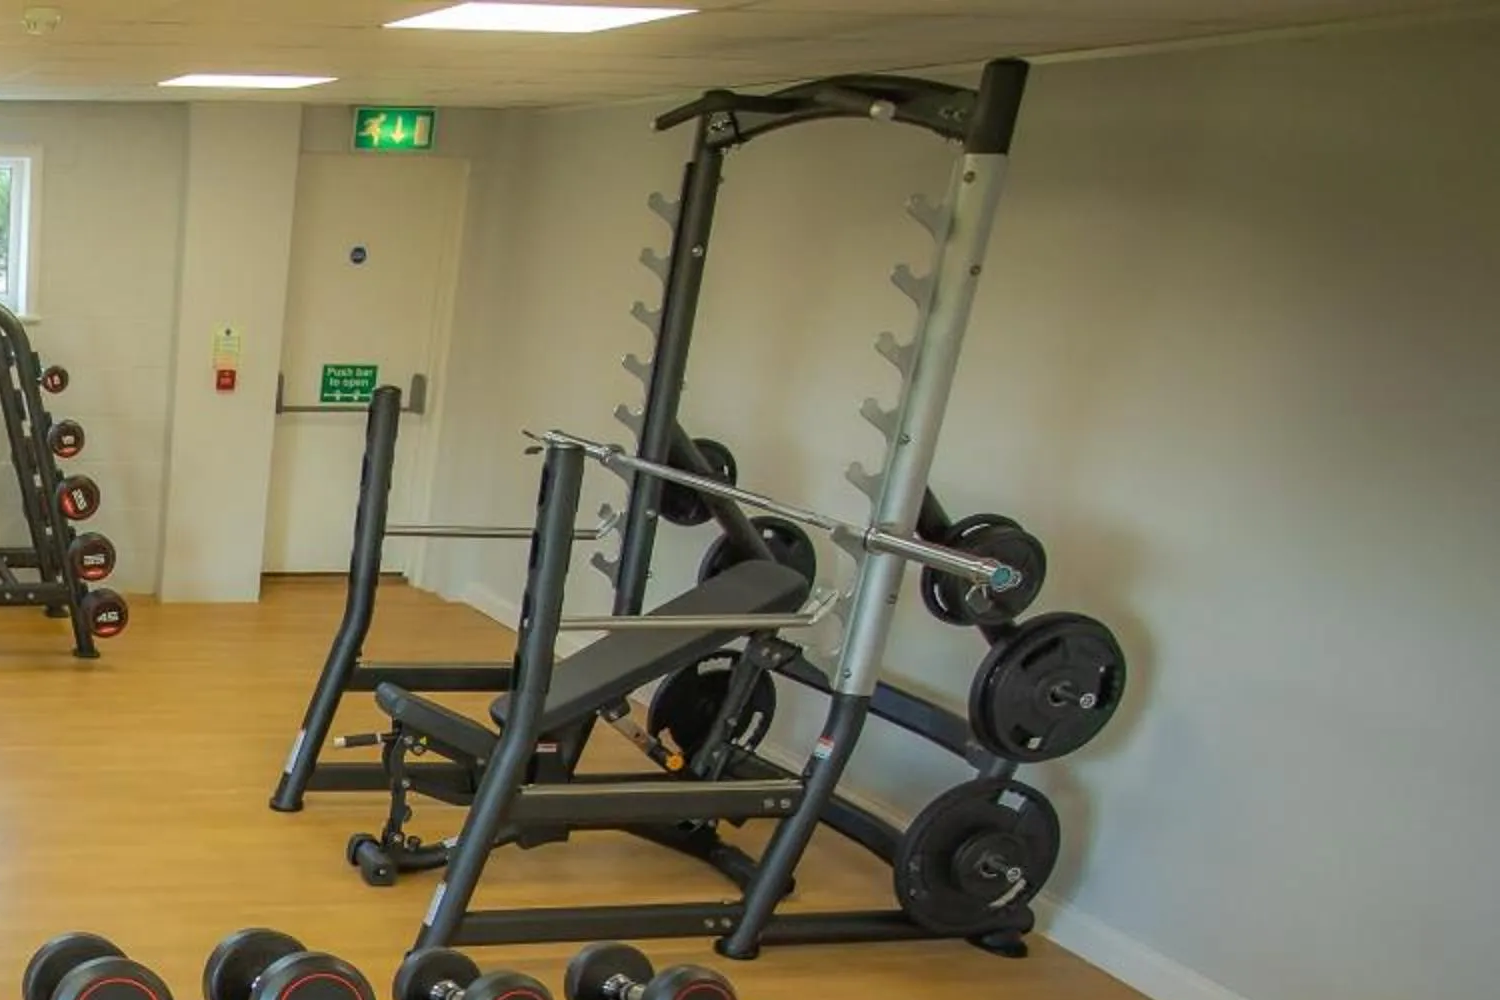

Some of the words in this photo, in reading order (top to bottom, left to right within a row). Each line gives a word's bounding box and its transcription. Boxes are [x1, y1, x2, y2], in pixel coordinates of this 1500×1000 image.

[327, 368, 353, 377] Push
[355, 368, 372, 377] bar
[329, 377, 340, 386] to
[343, 379, 369, 388] open
